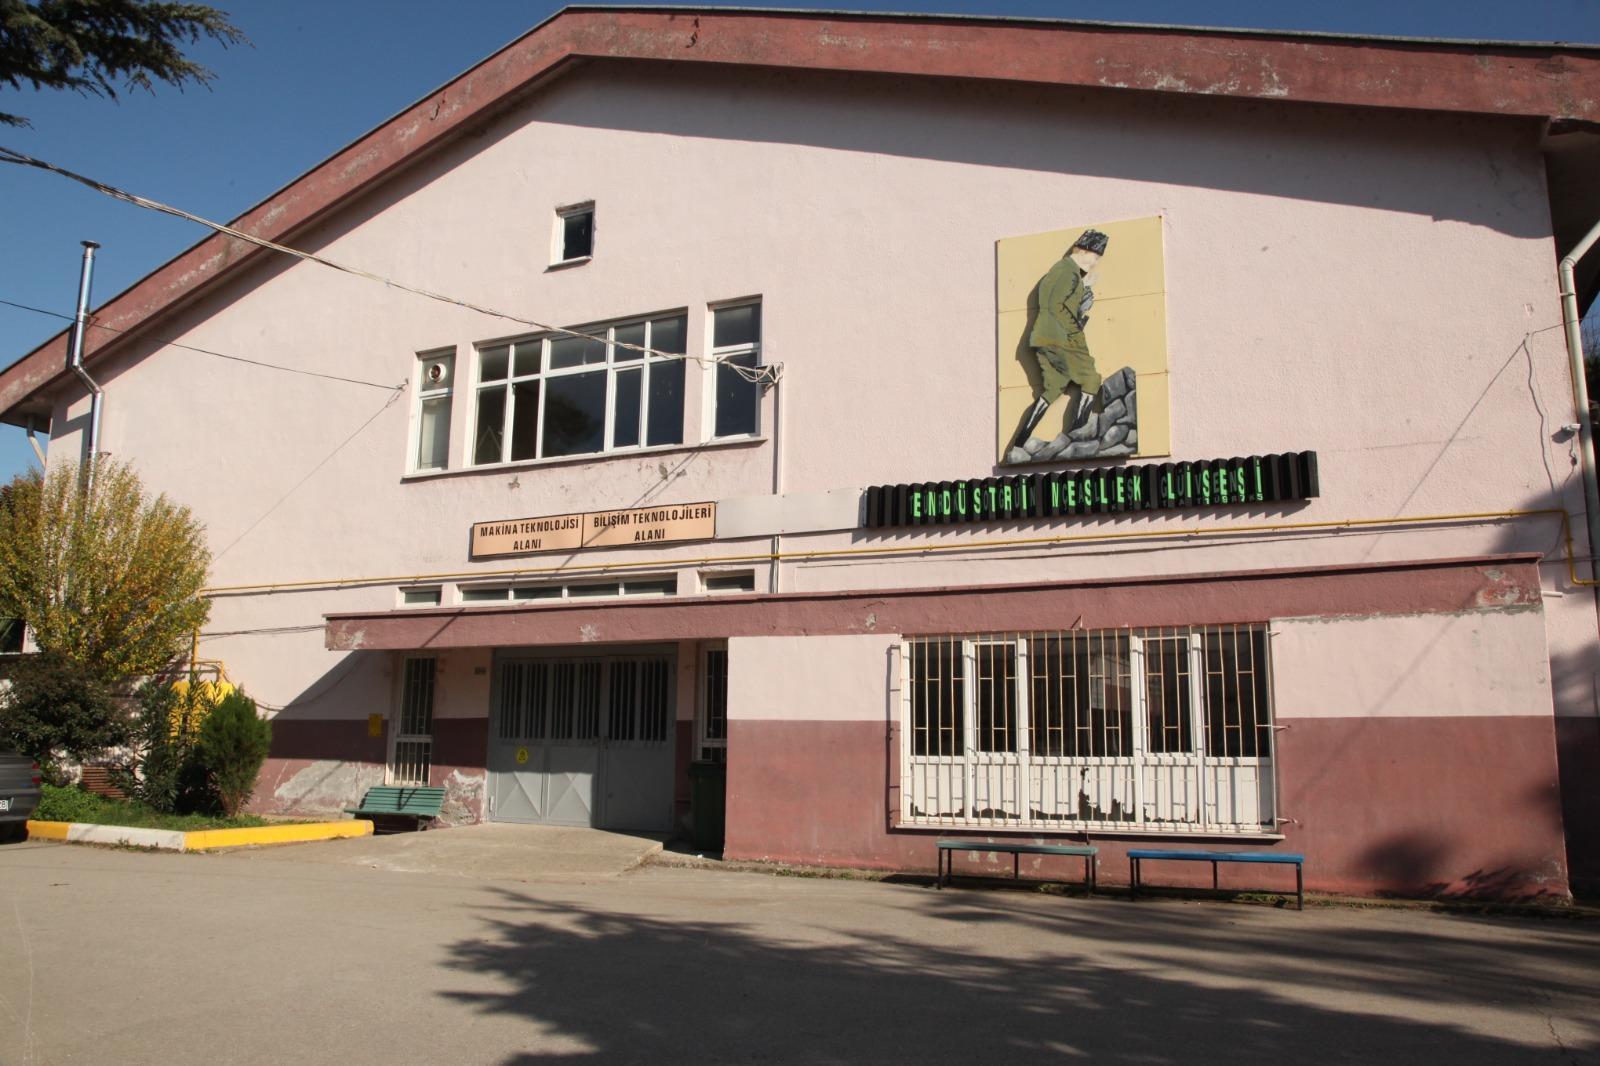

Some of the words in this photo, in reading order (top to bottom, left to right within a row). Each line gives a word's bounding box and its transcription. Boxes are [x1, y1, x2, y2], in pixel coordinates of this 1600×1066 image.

[913, 478, 1028, 517] ENDÜSTRİ
[1167, 459, 1262, 500] LİSESİ
[480, 522, 519, 537] MAKİNA
[520, 516, 580, 534] TEKNOLOJİSİ
[593, 510, 630, 529] BİLİŞİM
[633, 503, 712, 525] TEKNOLOJİLERİ
[512, 539, 542, 551] ALANI
[634, 528, 665, 542] ALANI
